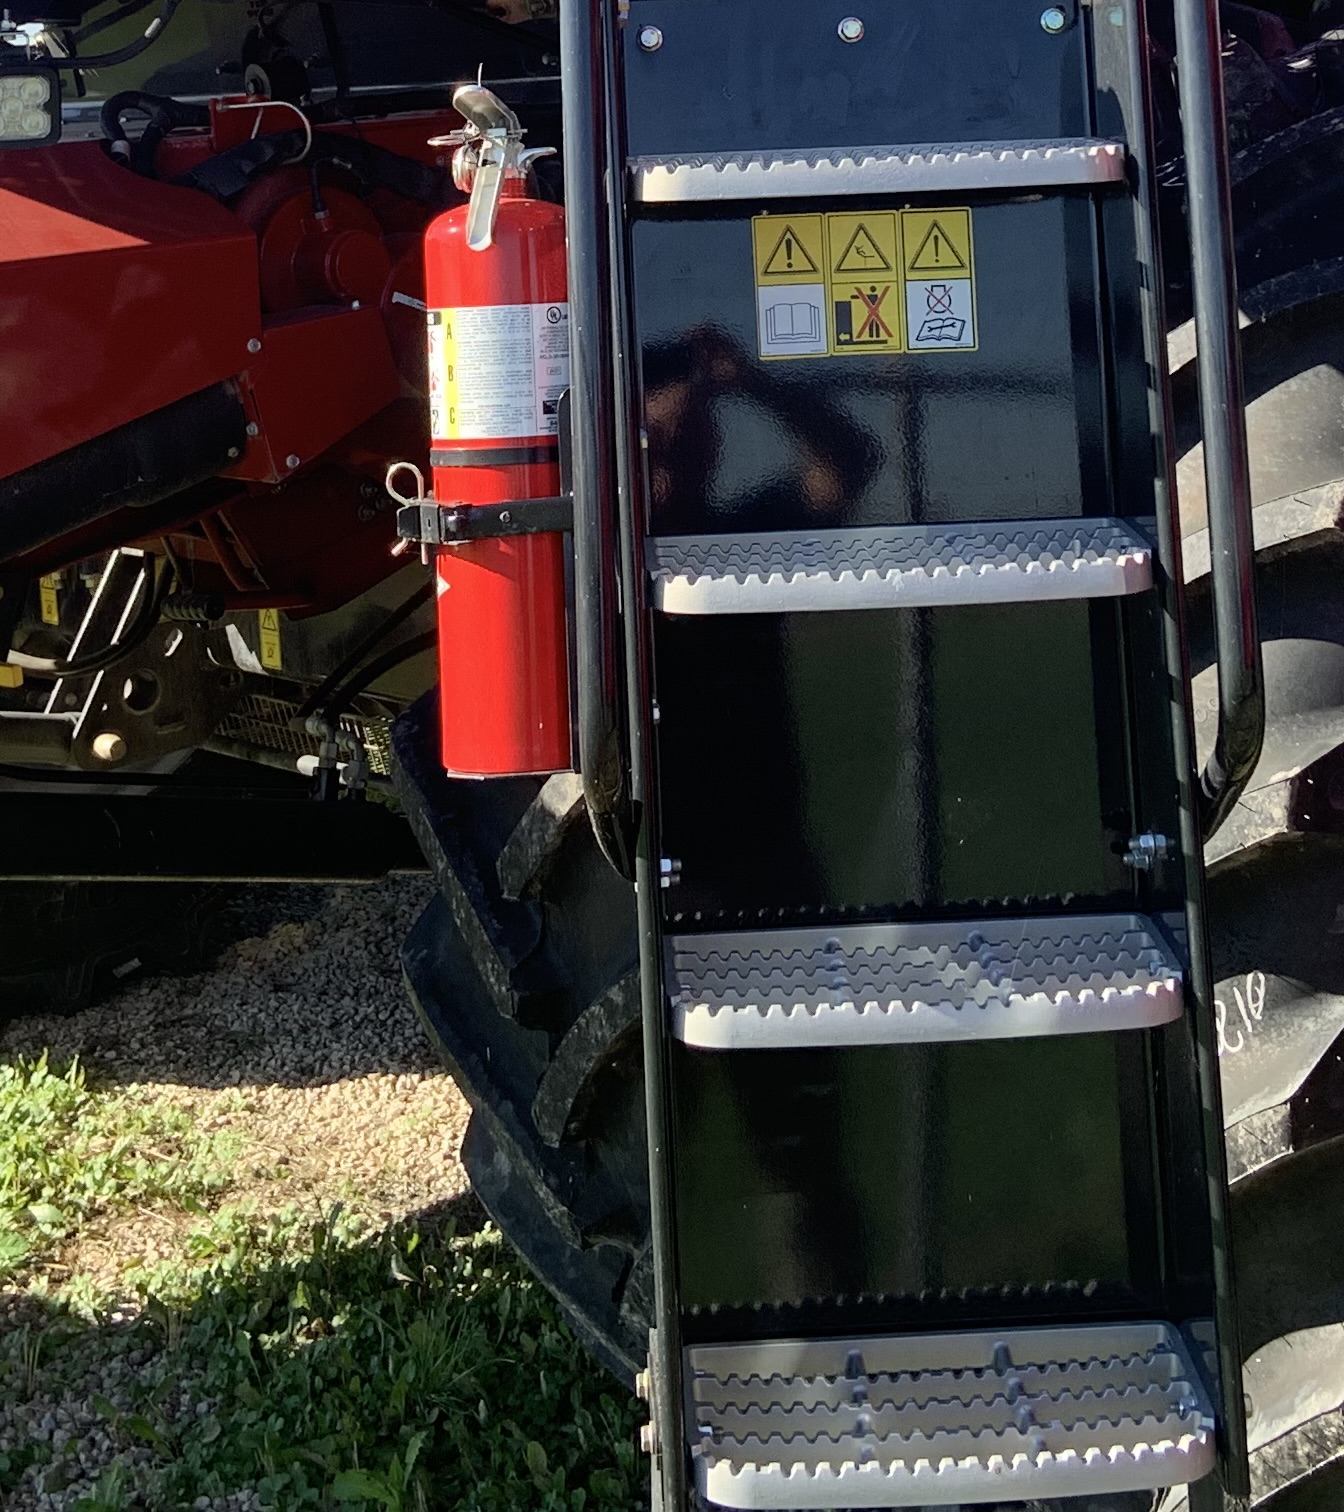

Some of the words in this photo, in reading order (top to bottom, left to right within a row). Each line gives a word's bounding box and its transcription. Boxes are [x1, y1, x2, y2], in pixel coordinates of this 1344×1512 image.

[446, 322, 453, 341] A
[447, 364, 454, 382] B
[449, 407, 456, 425] C
